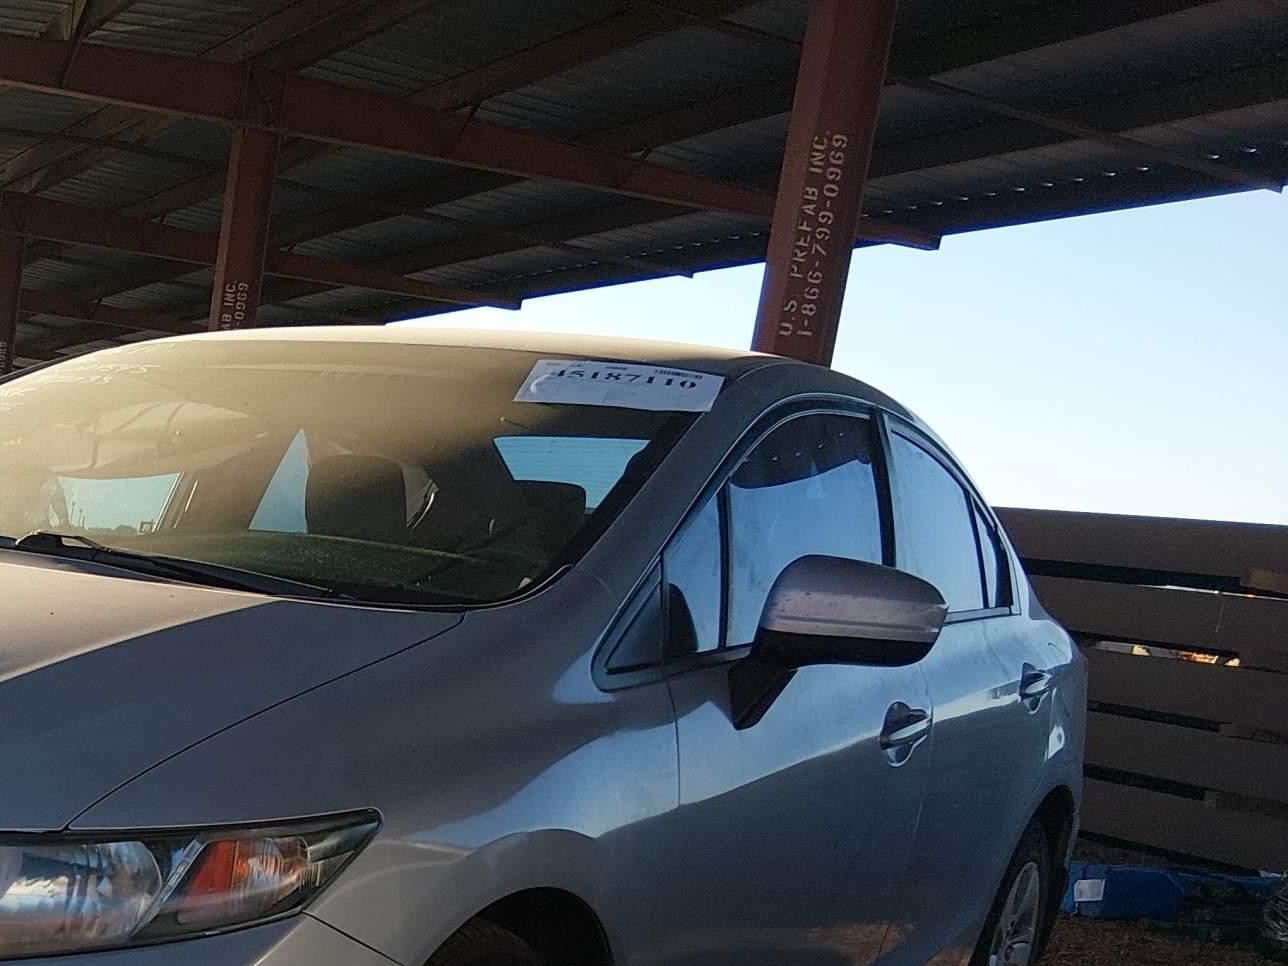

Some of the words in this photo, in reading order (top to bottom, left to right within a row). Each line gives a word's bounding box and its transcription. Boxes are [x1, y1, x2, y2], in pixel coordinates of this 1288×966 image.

[790, 186, 819, 278] PREFAB
[796, 133, 848, 337] 1-866-799-0969
[550, 368, 697, 390] 45187110
